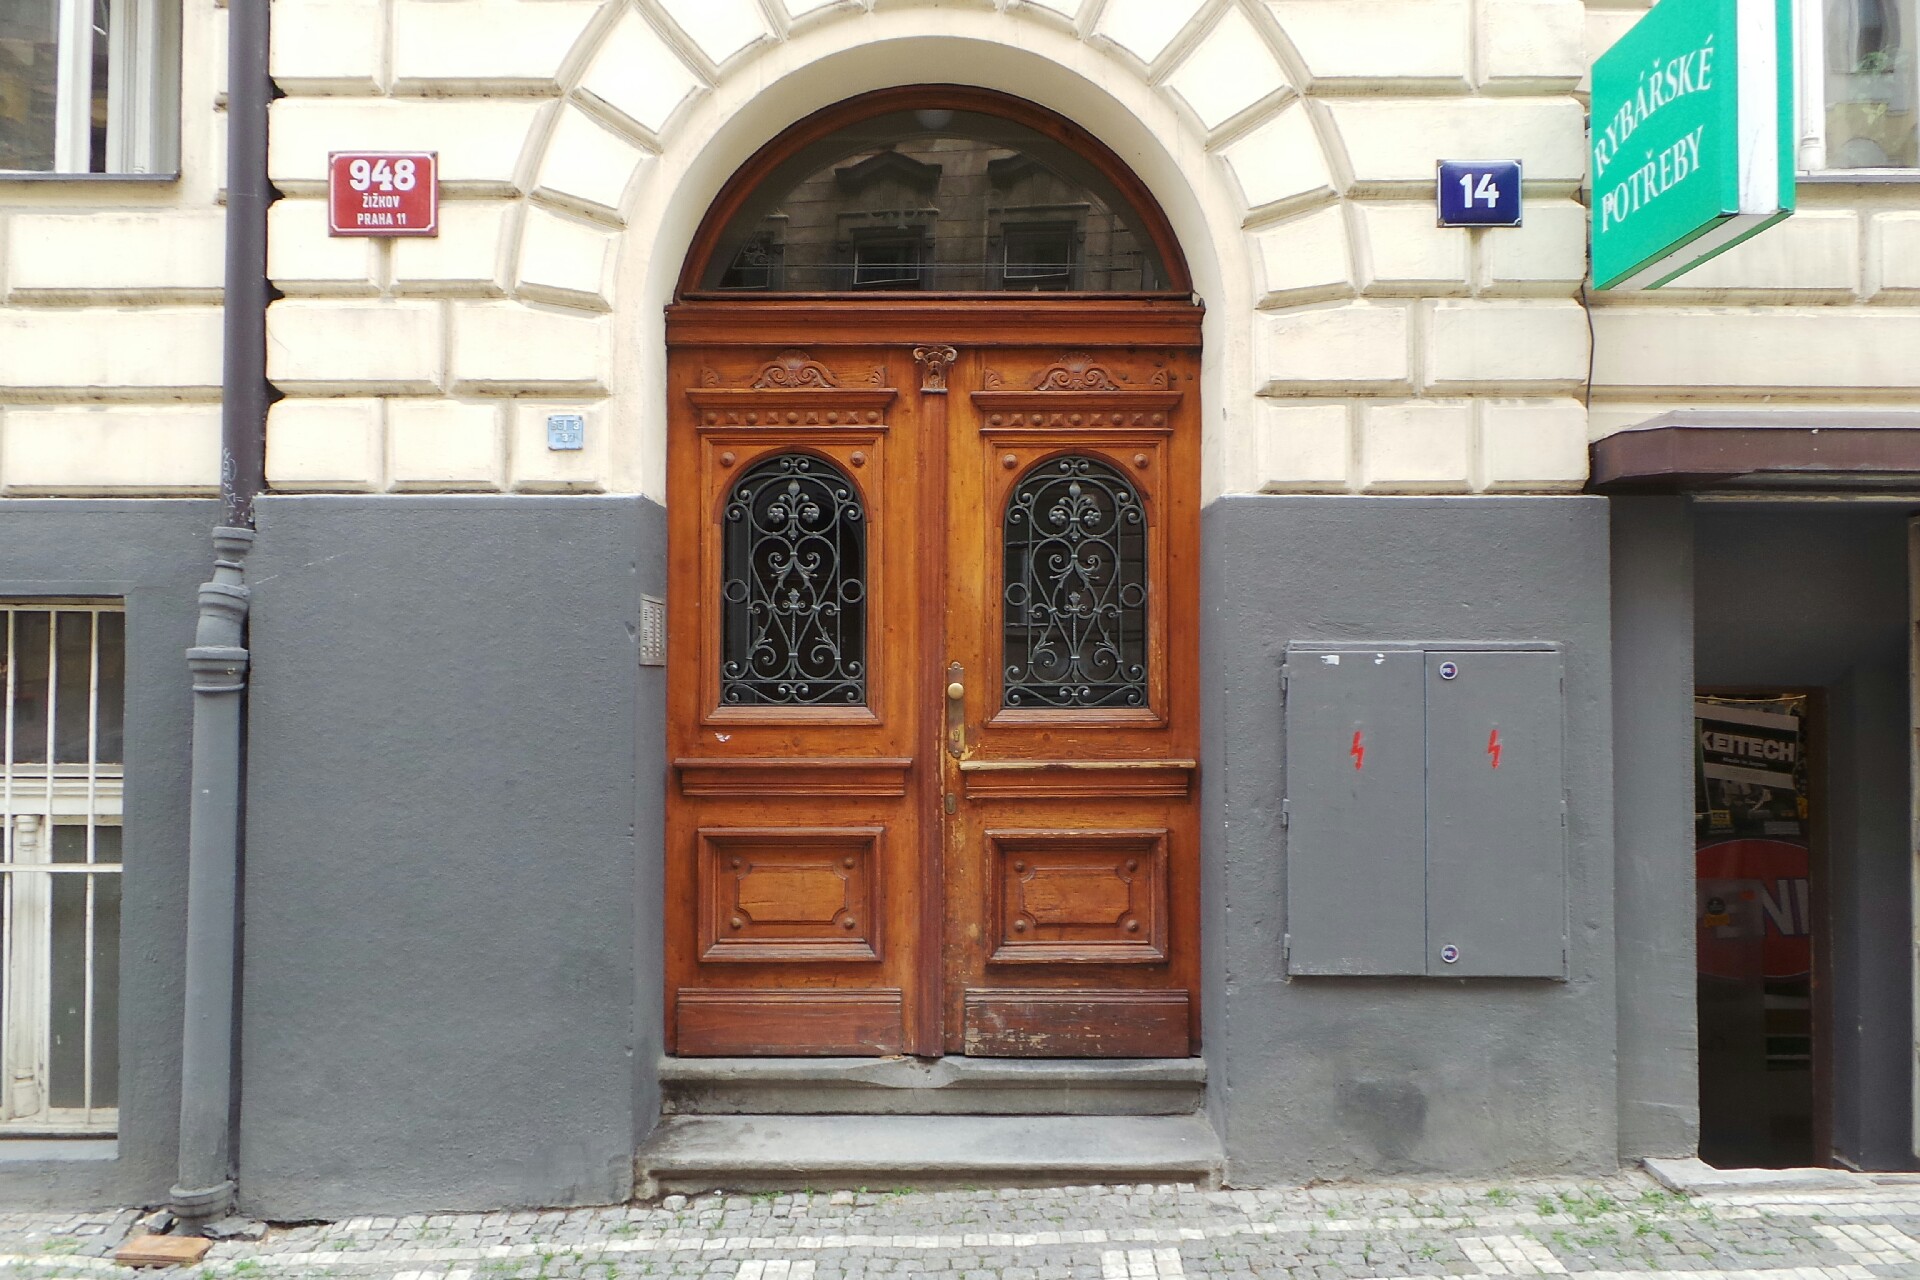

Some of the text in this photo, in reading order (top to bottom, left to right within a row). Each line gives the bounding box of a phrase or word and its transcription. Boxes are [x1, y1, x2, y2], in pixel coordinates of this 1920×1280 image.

[1594, 33, 1714, 178] RYBÁŘSKÉ
[349, 159, 416, 191] 948
[1459, 173, 1500, 208] 14
[1601, 124, 1704, 233] POTŘEBY
[362, 192, 400, 208] ŽIŽKOV
[357, 213, 406, 225] PRAHA 11
